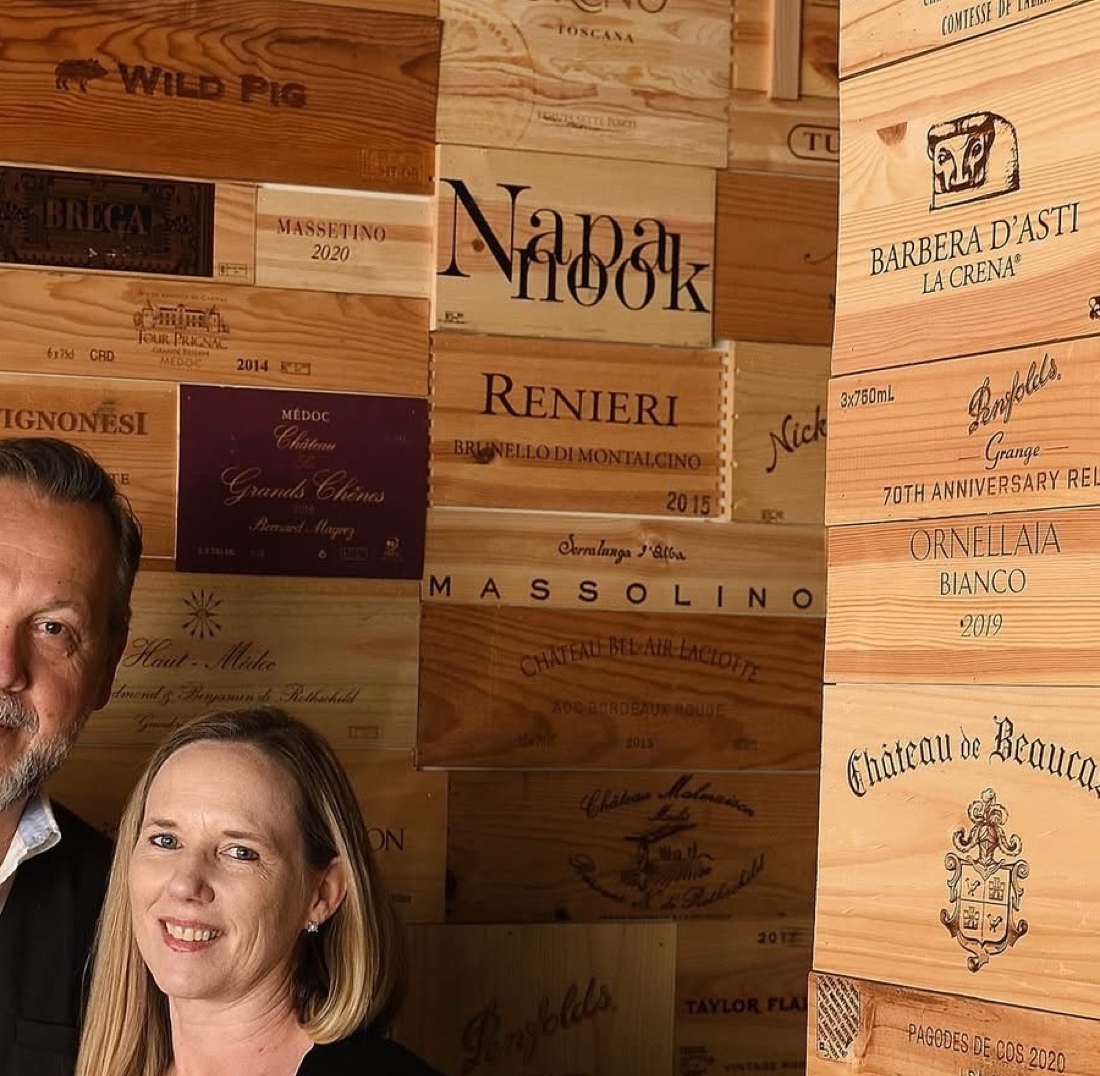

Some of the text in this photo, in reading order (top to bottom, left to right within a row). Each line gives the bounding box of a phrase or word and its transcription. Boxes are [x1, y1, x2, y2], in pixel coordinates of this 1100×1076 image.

[558, 22, 634, 44] TOSCANA
[941, 1, 992, 36] COMTESSE
[118, 63, 307, 109] WILD PIG
[277, 216, 387, 242] MASSETINO
[437, 178, 672, 290] Napa
[869, 202, 1081, 277] BARBERA D'ASTI
[311, 243, 350, 263] 2020
[510, 232, 711, 313] nook
[921, 270, 944, 295] LA
[137, 329, 228, 349] TOUR PRIGNAC
[90, 350, 116, 363] CRD
[236, 358, 269, 372] 2014
[281, 407, 331, 422] MÉDOC
[481, 371, 679, 427] RENIERI
[453, 438, 702, 470] BRUNELLO DI MONTALCINO
[985, 430, 1041, 470] Grange
[220, 466, 306, 508] Grands
[666, 491, 711, 516] 2015
[883, 483, 925, 506] 70TH
[931, 470, 1060, 502] ANNIVERSARY
[557, 533, 632, 565] Serralunga
[909, 521, 1062, 561] ORNELLAIA
[428, 575, 814, 610] MASSOLINO
[939, 567, 1027, 597] BIANCO
[960, 612, 1003, 638] 2019
[519, 641, 600, 678] CHÂTEAU
[679, 637, 762, 682] LACLOTTE
[846, 731, 953, 798] Château
[959, 724, 981, 762] de
[685, 998, 760, 1016] TAYLOR
[908, 1022, 1067, 1074] PAGODES DE COS 2020
